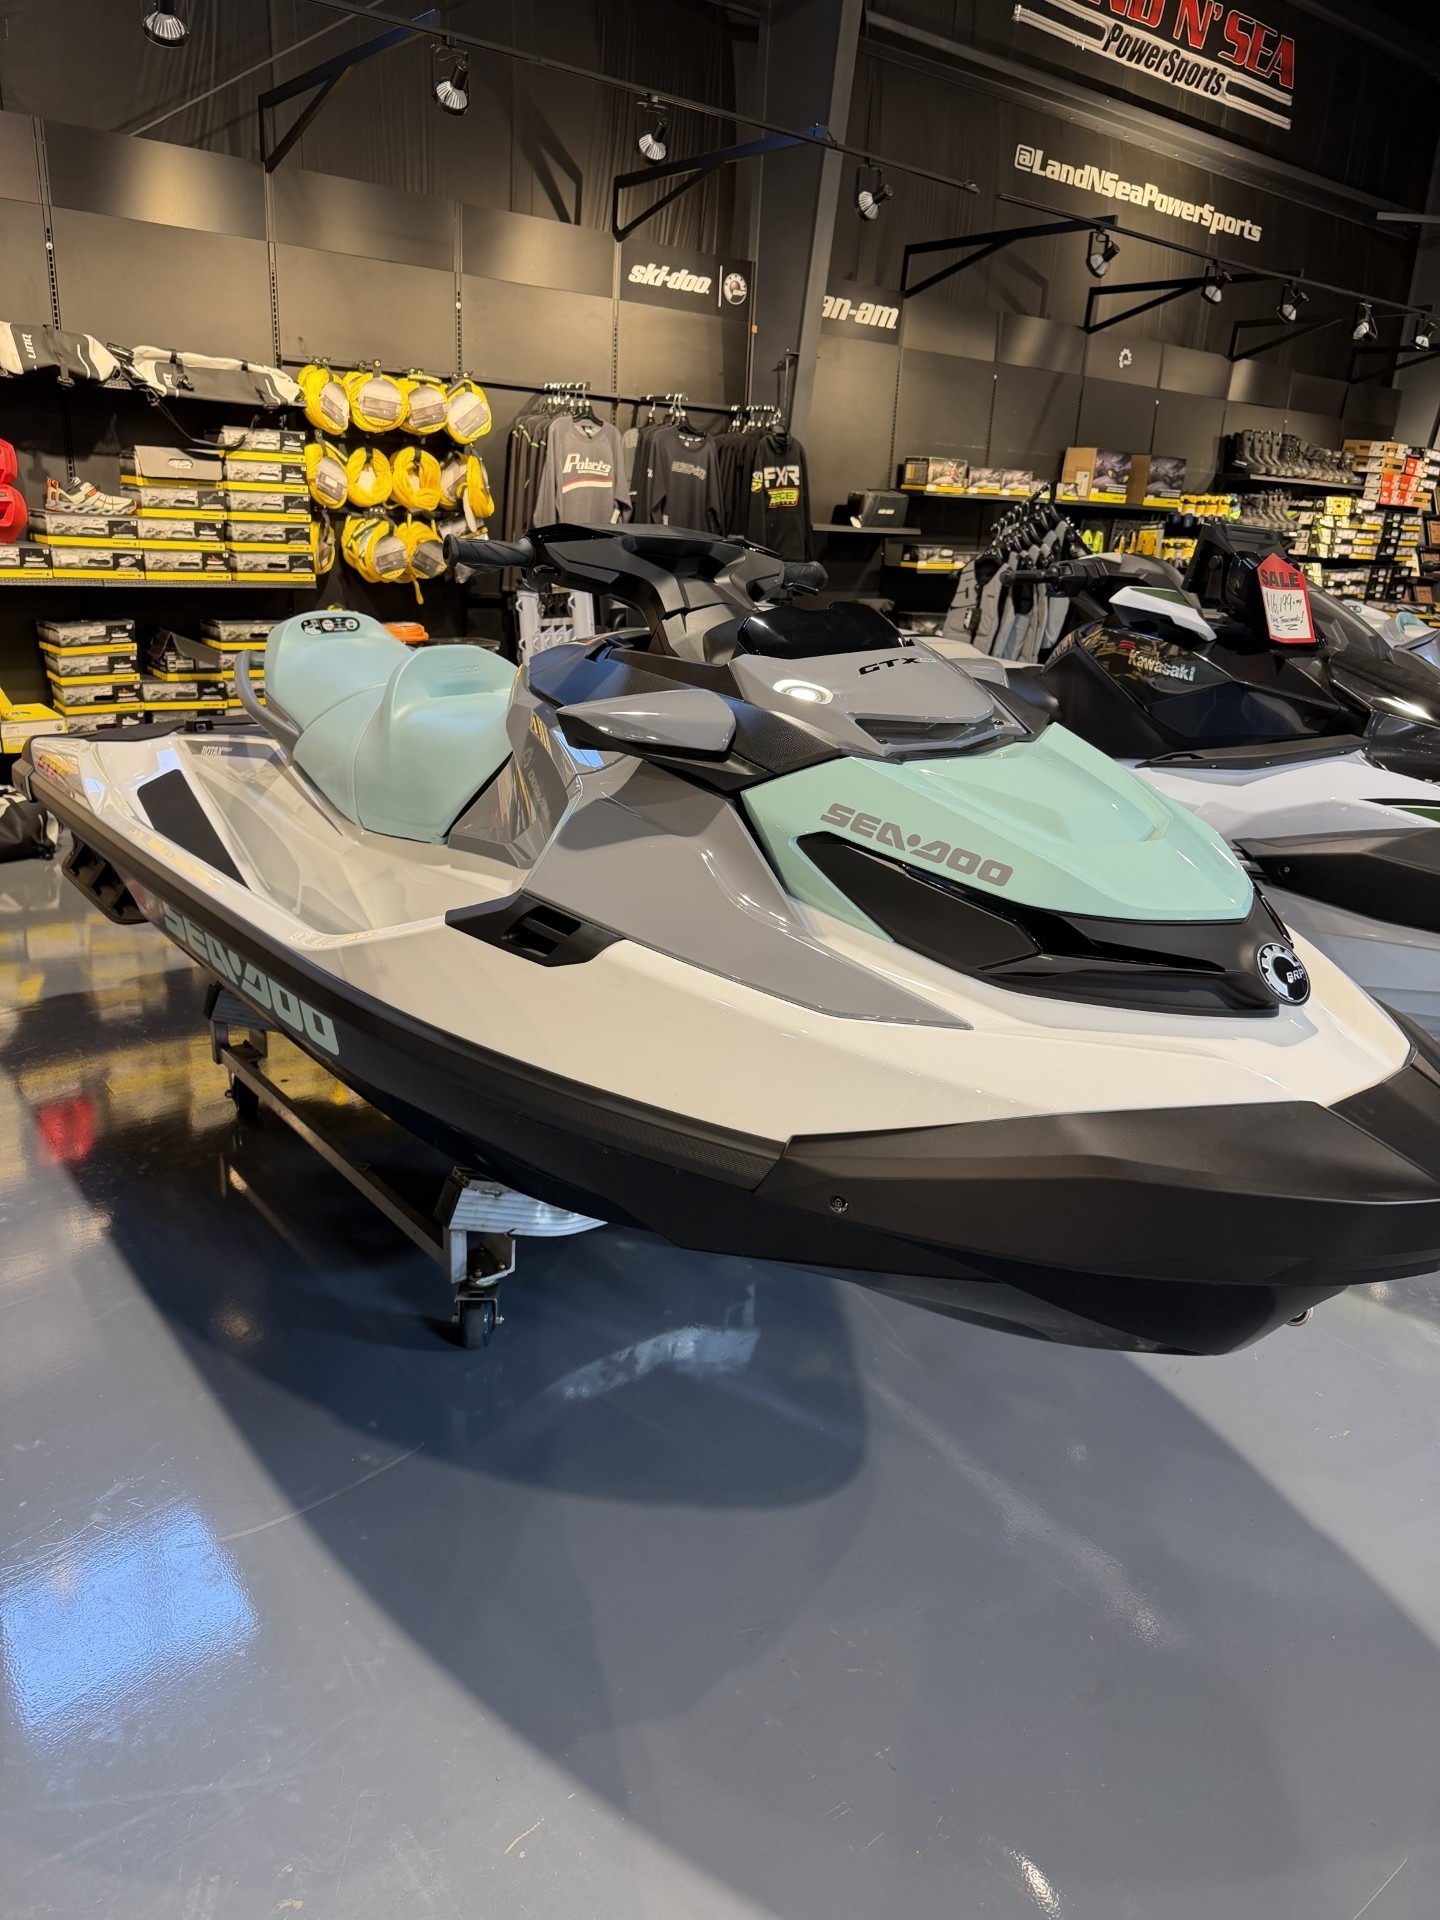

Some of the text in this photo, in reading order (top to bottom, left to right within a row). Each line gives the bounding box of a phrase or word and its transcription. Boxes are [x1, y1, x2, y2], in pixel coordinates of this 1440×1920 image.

[1103, 23, 1226, 97] PowerSports
[1218, 9, 1295, 89] SEA
[1014, 144, 1263, 242] @LandNSeaPowerSports
[628, 263, 712, 294] ski-doo
[821, 295, 899, 329] an-am
[562, 453, 612, 477] Polaris
[763, 465, 800, 488] FXR
[1260, 568, 1301, 588] SALE
[859, 657, 920, 675] GTX
[1127, 649, 1196, 682] Kawasaki
[1286, 968, 1304, 984] BRP
